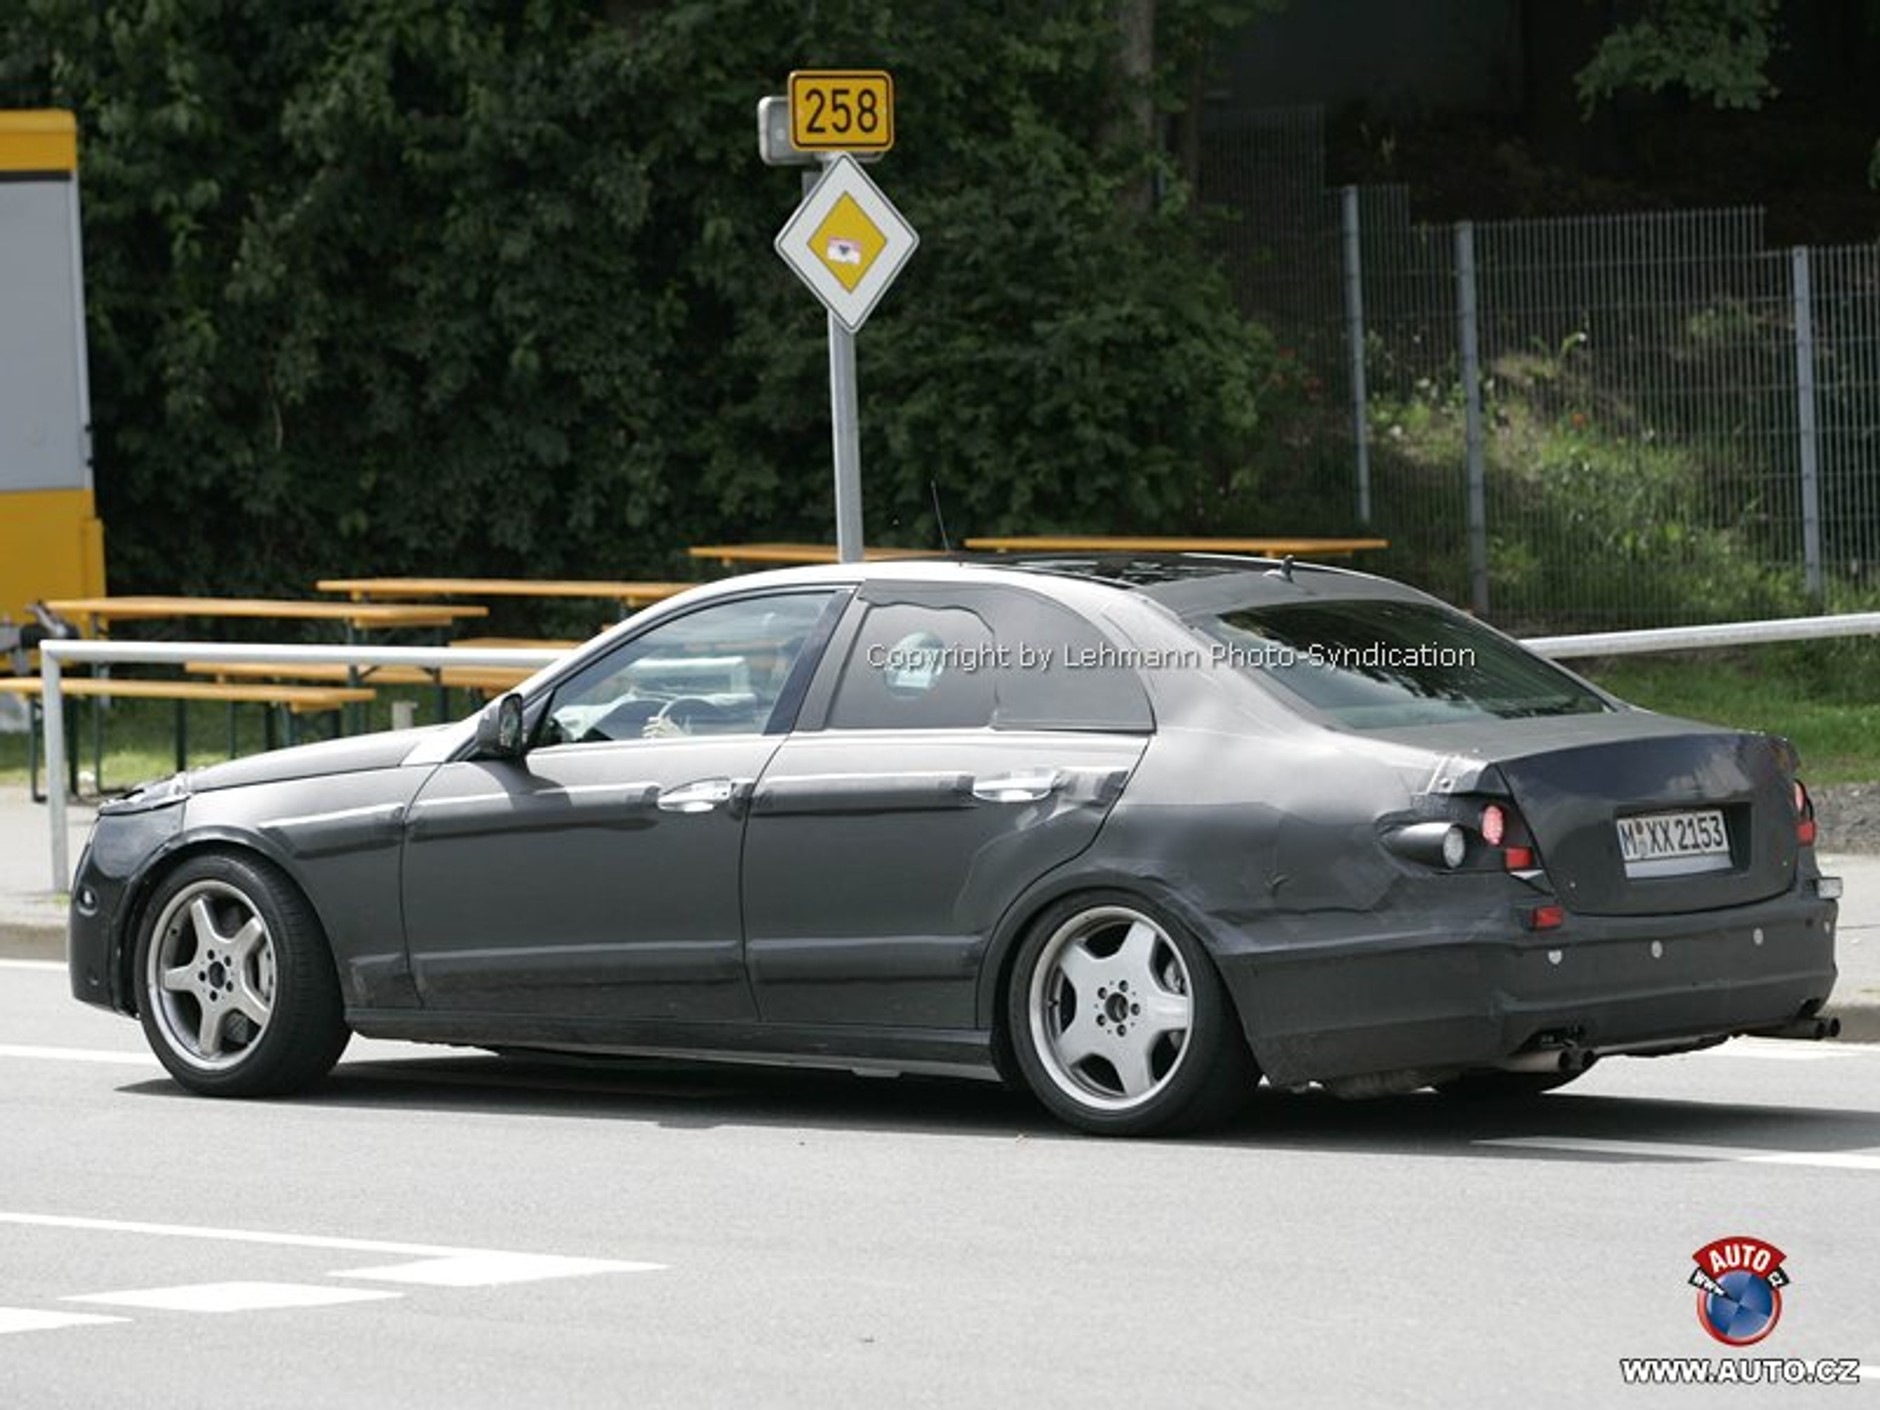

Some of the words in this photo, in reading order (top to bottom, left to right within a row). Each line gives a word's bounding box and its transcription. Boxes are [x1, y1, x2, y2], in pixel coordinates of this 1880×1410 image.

[804, 88, 879, 134] 258
[1618, 822, 1638, 857] M
[1646, 819, 1675, 854] XX
[1675, 815, 1724, 850] 2153
